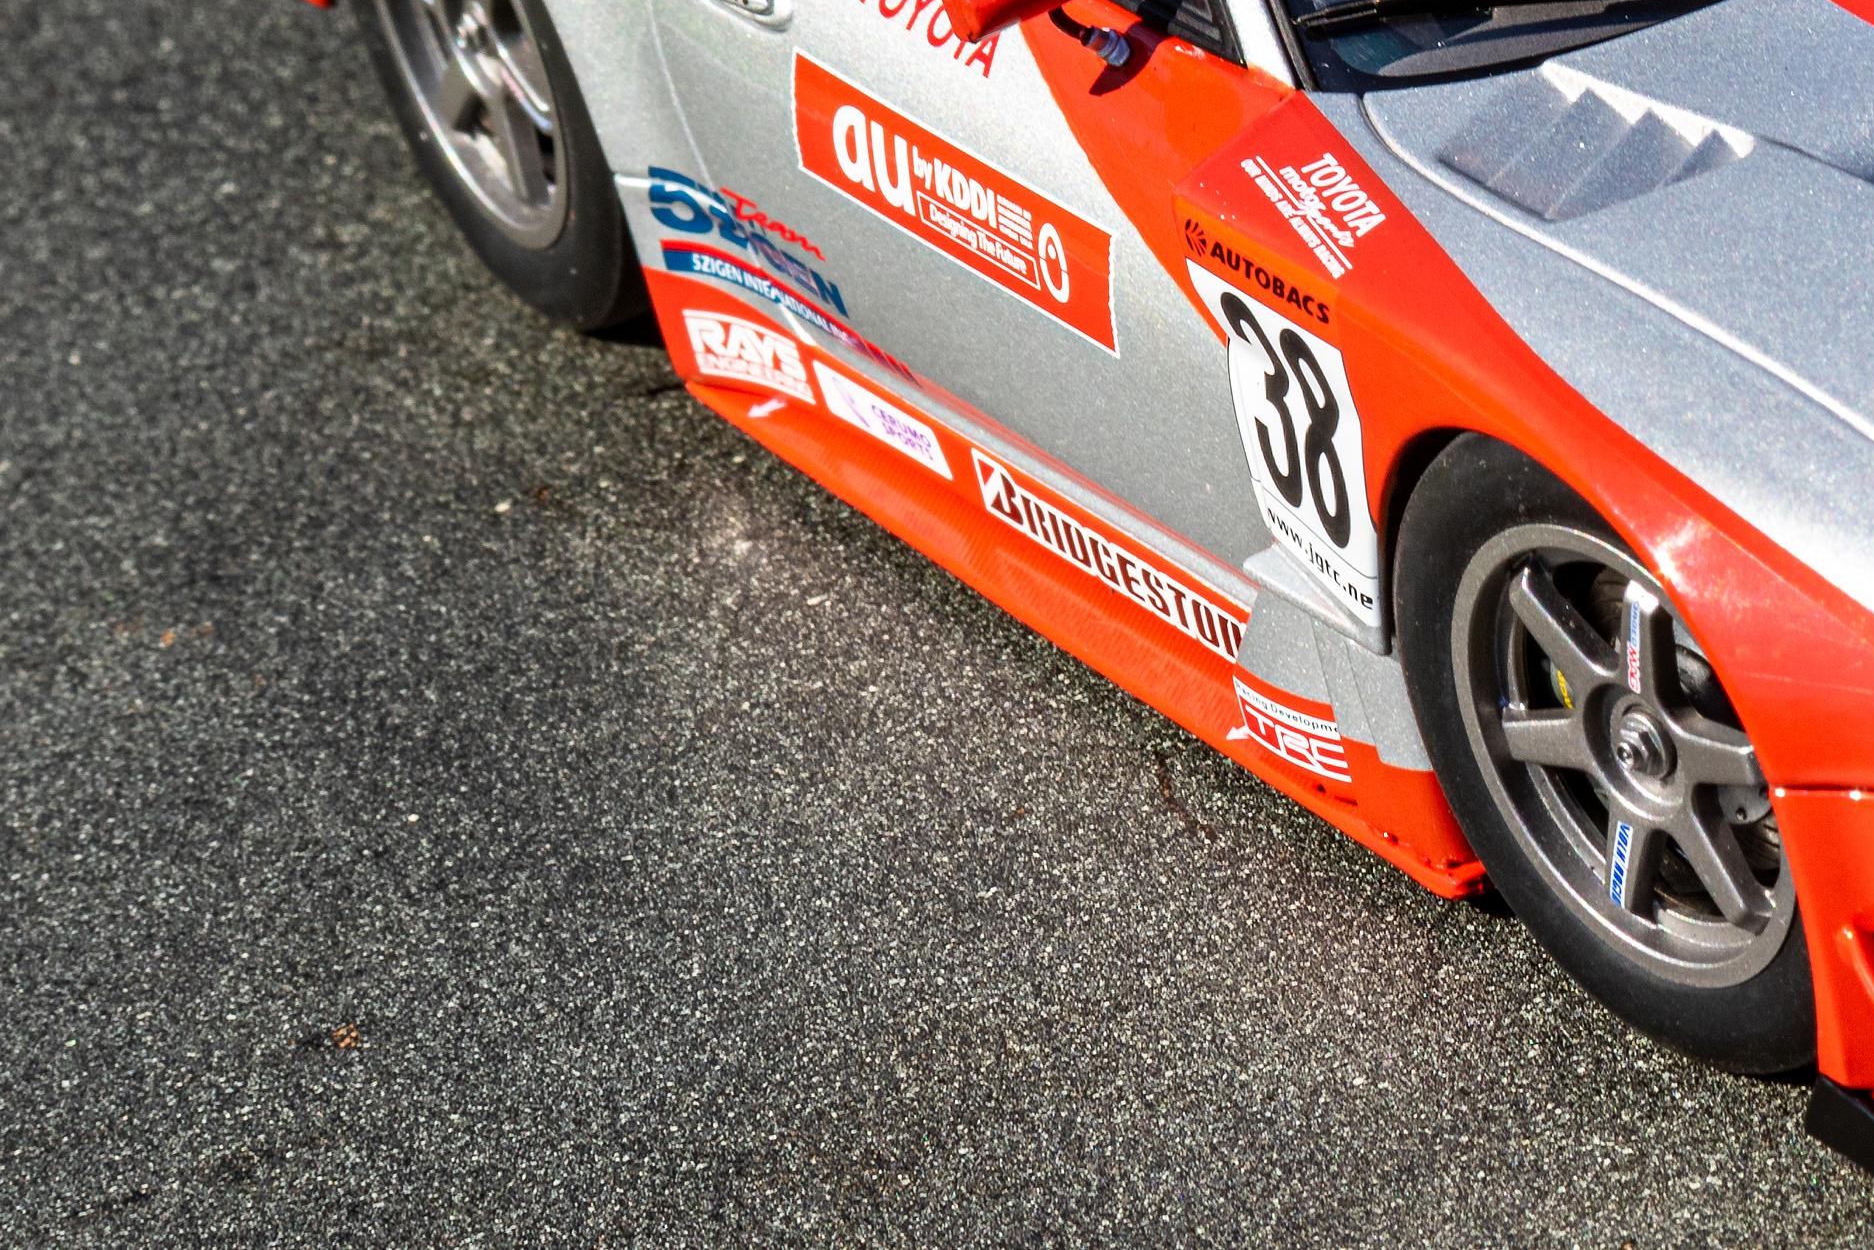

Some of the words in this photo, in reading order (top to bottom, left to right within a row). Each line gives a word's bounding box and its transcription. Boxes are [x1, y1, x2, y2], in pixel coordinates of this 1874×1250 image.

[832, 104, 916, 217] au
[912, 145, 933, 191] by
[933, 157, 1001, 230] KDDI
[1300, 152, 1387, 238] TOYOTA
[929, 203, 978, 248] Designing
[977, 227, 998, 256] The
[1210, 242, 1330, 325] AUTOBACS
[685, 316, 808, 380] RAYS
[1219, 290, 1352, 549] 38
[991, 471, 1247, 660] BRIDGESTON
